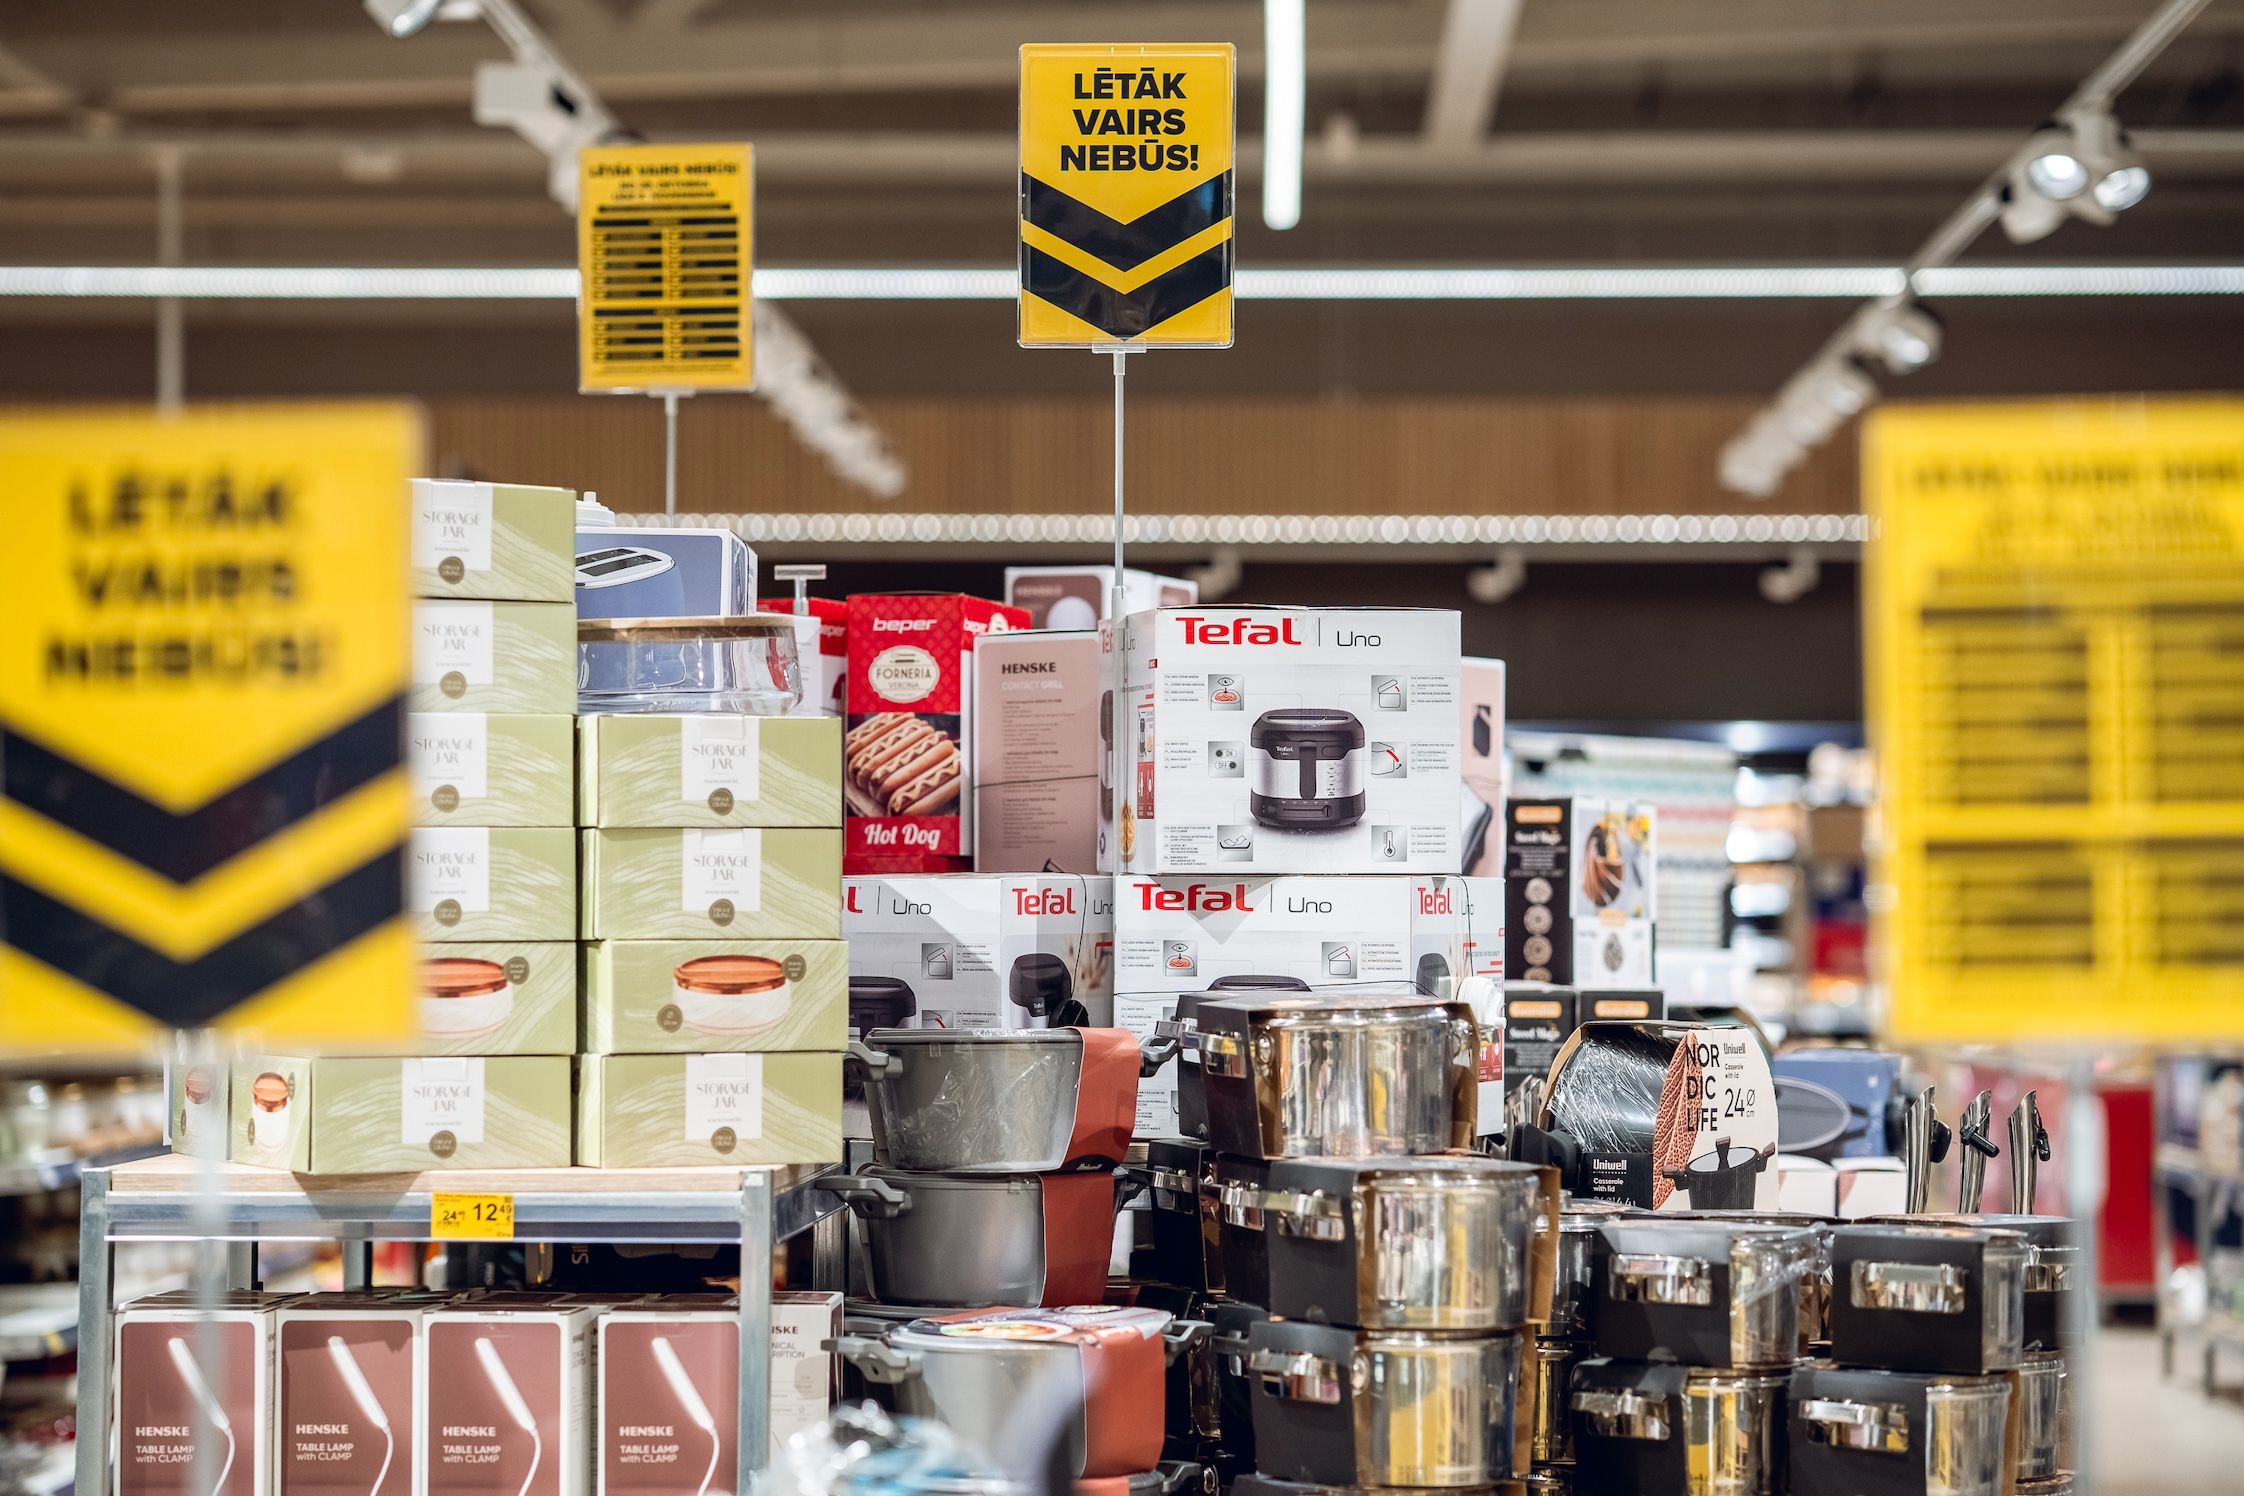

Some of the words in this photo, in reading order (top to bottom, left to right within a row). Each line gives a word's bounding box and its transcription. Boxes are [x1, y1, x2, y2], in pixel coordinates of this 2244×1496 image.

[1074, 67, 1187, 99] LĒTĀK
[1073, 109, 1186, 136] VAIRS
[1061, 139, 1199, 171] NEBŪS!
[423, 511, 480, 526] STORAGE
[441, 526, 465, 539] JAR
[423, 624, 480, 638] STORAGE
[873, 617, 937, 634] beper
[1175, 617, 1302, 646] Tefal
[1337, 630, 1381, 647] Uno
[442, 639, 466, 651] JAR
[876, 667, 931, 680] FORNERIA
[1002, 662, 1057, 674] HENSKE
[414, 738, 474, 751] STORAGE
[692, 744, 748, 757] STORAGE
[434, 752, 459, 764] JAR
[709, 758, 734, 770] JAR
[864, 823, 898, 845] Hot
[902, 823, 941, 851] Dog
[416, 852, 476, 865] STORAGE
[692, 855, 750, 868] STORAGE
[436, 866, 462, 878] JAR
[711, 869, 735, 881] JAR
[1012, 888, 1076, 915] Tefal
[1133, 883, 1254, 912] Tefal
[1288, 897, 1333, 914] Uno
[1417, 887, 1452, 915] Tefal
[892, 898, 932, 915] Uno
[1723, 1042, 1746, 1054] Uniwell
[1686, 1043, 1720, 1068] NOR
[413, 1085, 472, 1099] STORAGE
[695, 1082, 751, 1096] STORAGE
[1687, 1075, 1716, 1100] DIC
[432, 1100, 457, 1112] JAR
[713, 1096, 737, 1108] JAR
[1724, 1088, 1745, 1118] 24
[1687, 1107, 1718, 1132] LIFE
[1593, 1159, 1627, 1171] Uniwell
[1593, 1177, 1625, 1185] Casserole
[1607, 1185, 1616, 1193] lid
[135, 1426, 190, 1437] HENSKE
[296, 1424, 349, 1435] HENSKE
[443, 1426, 496, 1437] HENSKE
[619, 1426, 673, 1437] HENSKE
[136, 1445, 166, 1454] TABLE
[296, 1443, 325, 1452] TABLE
[327, 1443, 354, 1452] LAMP
[443, 1445, 472, 1454] TABLE
[474, 1445, 501, 1454] LAMP
[620, 1445, 649, 1454] TABLE
[651, 1445, 679, 1454] LAMP
[136, 1454, 156, 1463] with
[157, 1454, 193, 1463] CLAMP
[296, 1452, 316, 1461] with
[318, 1452, 352, 1461] CLAMP
[443, 1454, 463, 1463] with
[465, 1454, 499, 1463] CLAMP
[620, 1454, 640, 1463] with
[642, 1454, 677, 1463] CLAMP
